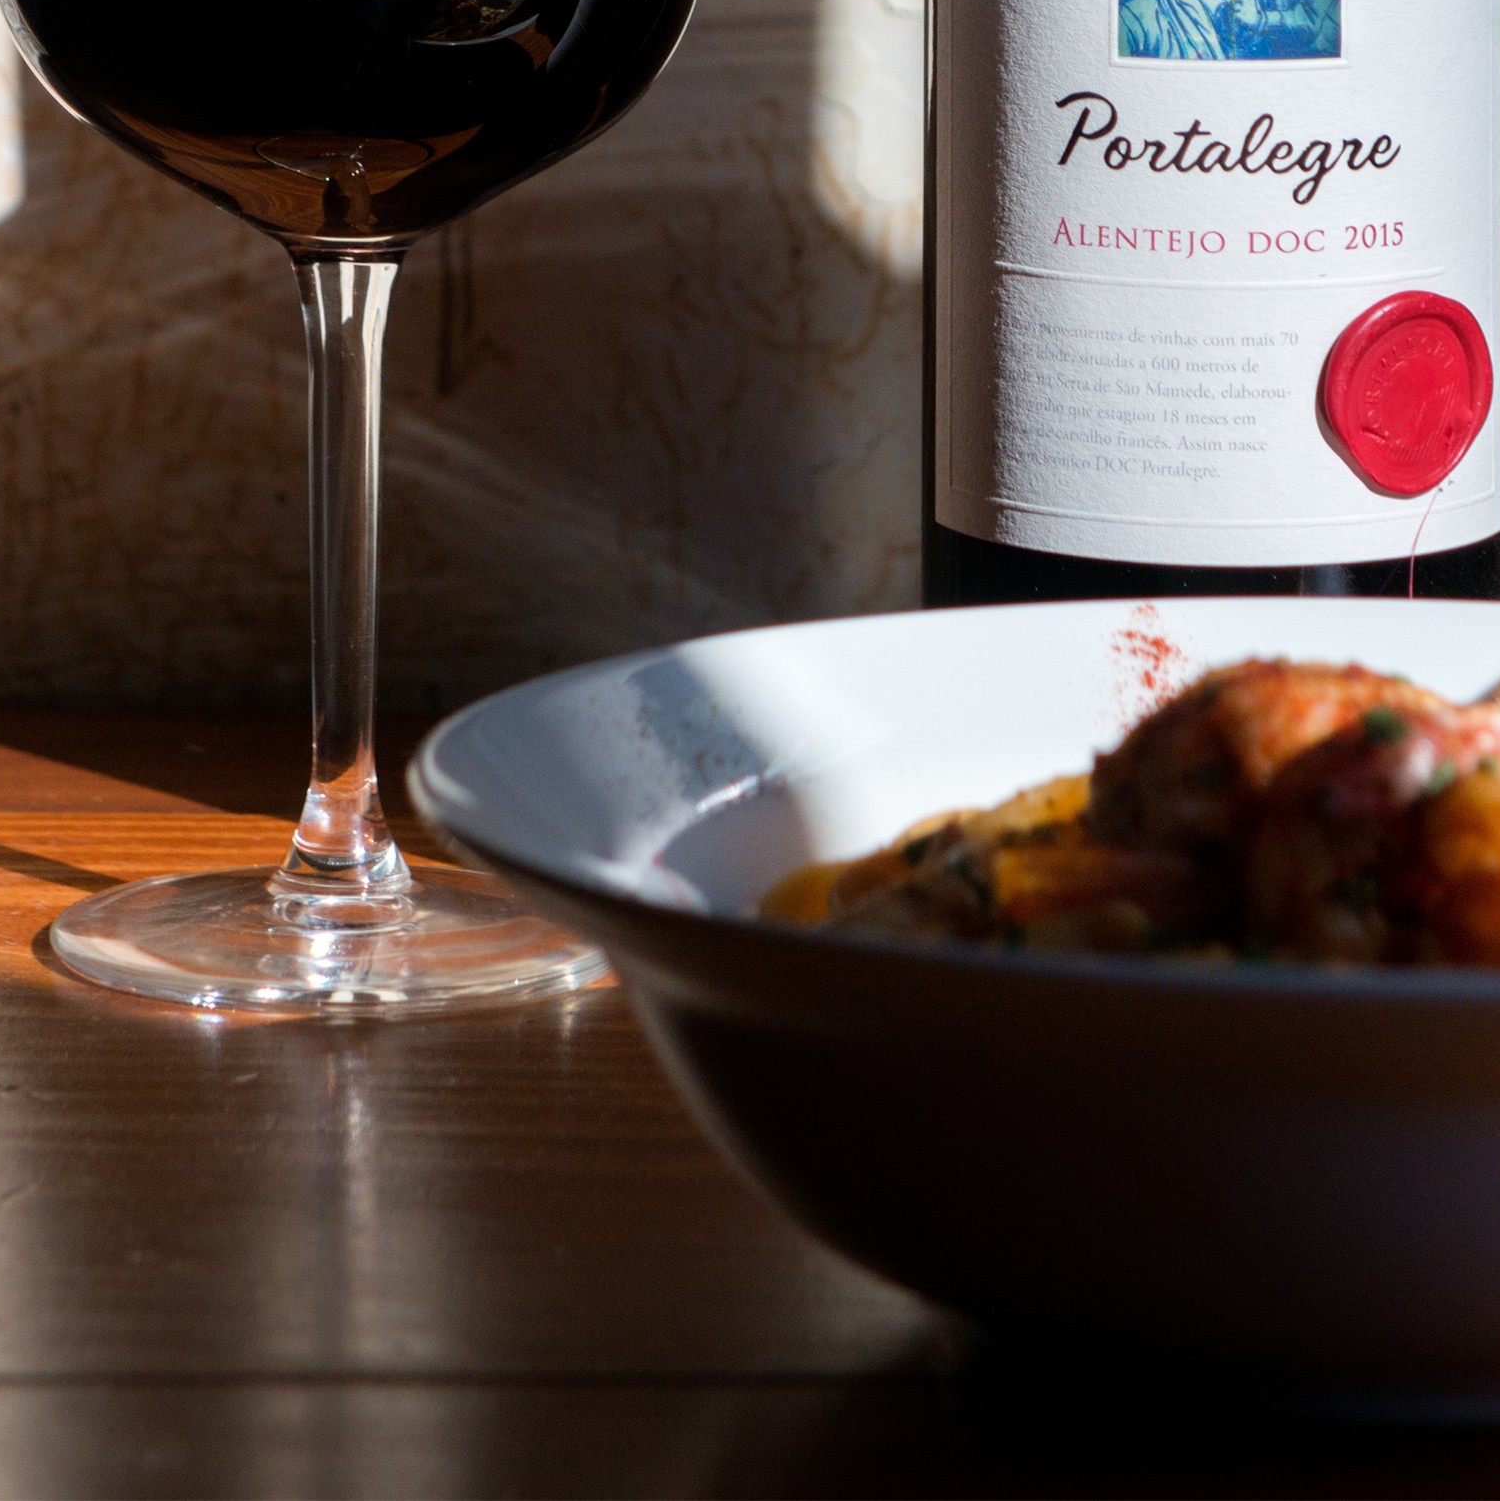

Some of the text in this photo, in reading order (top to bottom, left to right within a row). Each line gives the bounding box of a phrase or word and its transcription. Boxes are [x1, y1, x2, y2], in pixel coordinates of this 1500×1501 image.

[1055, 91, 1401, 205] Portalegre
[1052, 217, 1404, 259] ALENTEJO DOC 2015
[1128, 327, 1145, 343] de
[1150, 330, 1198, 346] vinhas
[1202, 336, 1235, 347] com
[1241, 332, 1275, 347] mais
[1279, 331, 1299, 346] 70
[1139, 359, 1146, 370] a
[1151, 356, 1180, 371] 600
[1186, 360, 1237, 373] metros
[1241, 357, 1260, 373] de
[1094, 378, 1110, 393] de
[1145, 381, 1215, 400] Mamede,
[1221, 383, 1291, 399] elaborou-
[1068, 406, 1092, 420] que
[1097, 407, 1156, 424] estagiou
[1163, 409, 1179, 424] 18
[1185, 413, 1229, 425] meses
[1233, 414, 1256, 425] em
[1177, 435, 1223, 451] Assim
[1228, 440, 1268, 452] nasce
[1095, 455, 1137, 474] DOC
[1142, 459, 1221, 482] Portalegre.
